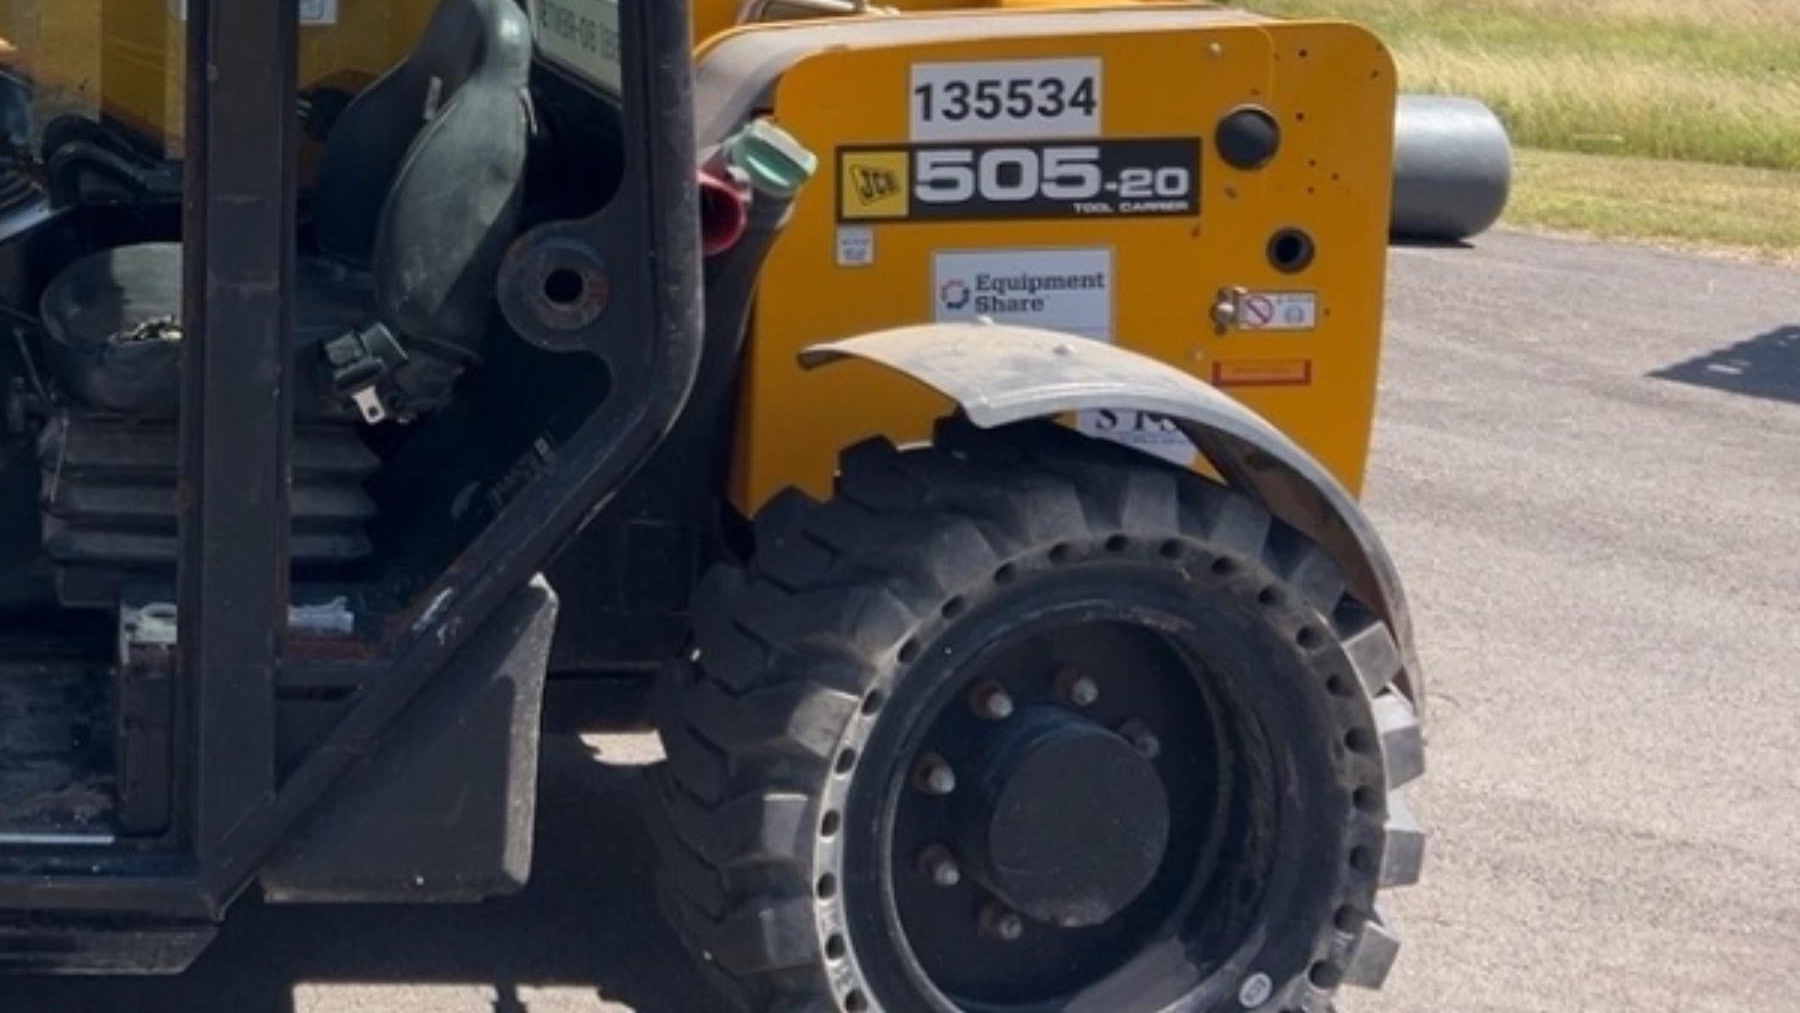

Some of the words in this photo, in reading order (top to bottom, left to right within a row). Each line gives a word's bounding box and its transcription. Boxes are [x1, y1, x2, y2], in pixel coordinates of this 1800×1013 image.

[914, 76, 1096, 121] 135534
[1073, 201, 1113, 214] TOOL
[974, 273, 1105, 295] Equipment
[974, 295, 1045, 313] Share
